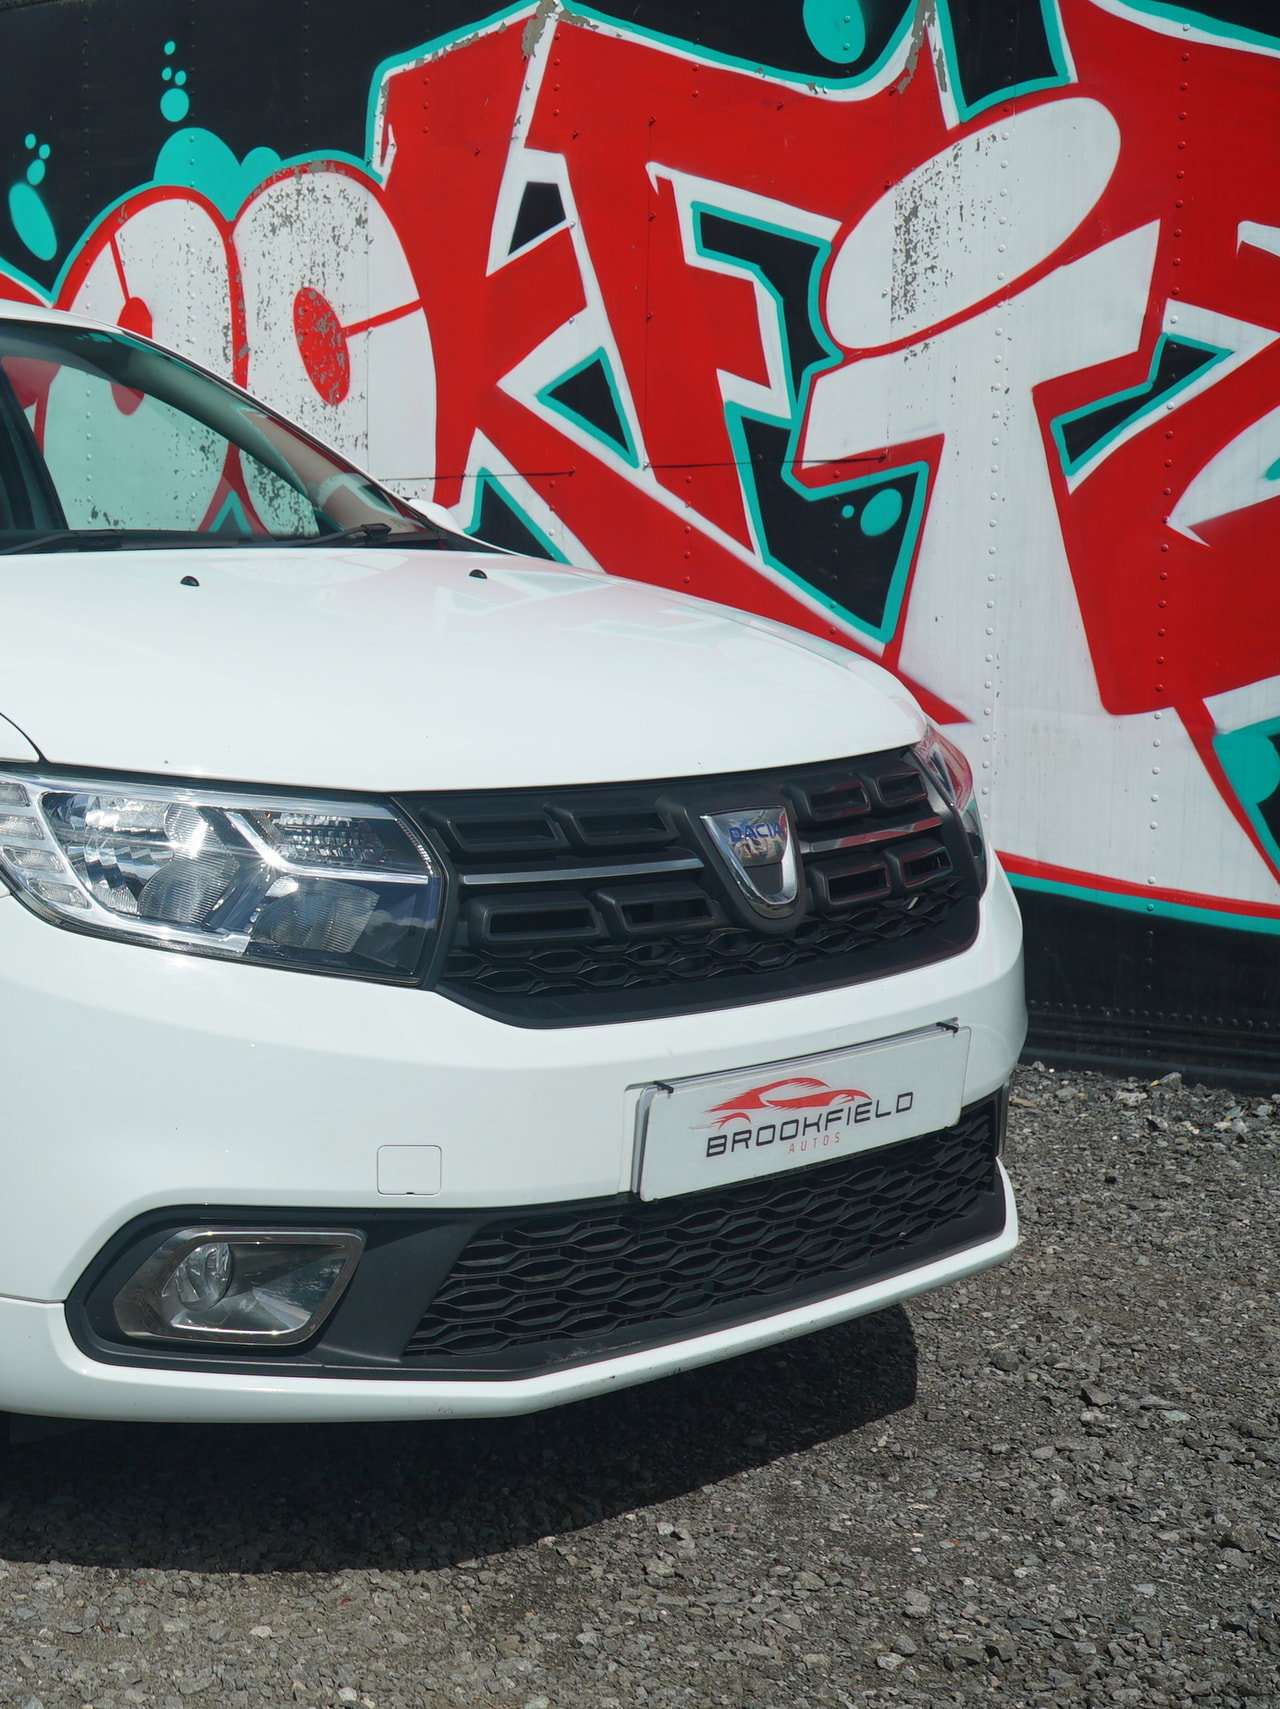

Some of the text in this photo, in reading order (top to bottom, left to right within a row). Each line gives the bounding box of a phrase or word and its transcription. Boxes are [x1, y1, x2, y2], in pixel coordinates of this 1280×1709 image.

[729, 822, 784, 843] DACIA
[706, 1092, 914, 1158] BROOKFIELD
[788, 1131, 841, 1153] AUTOS
